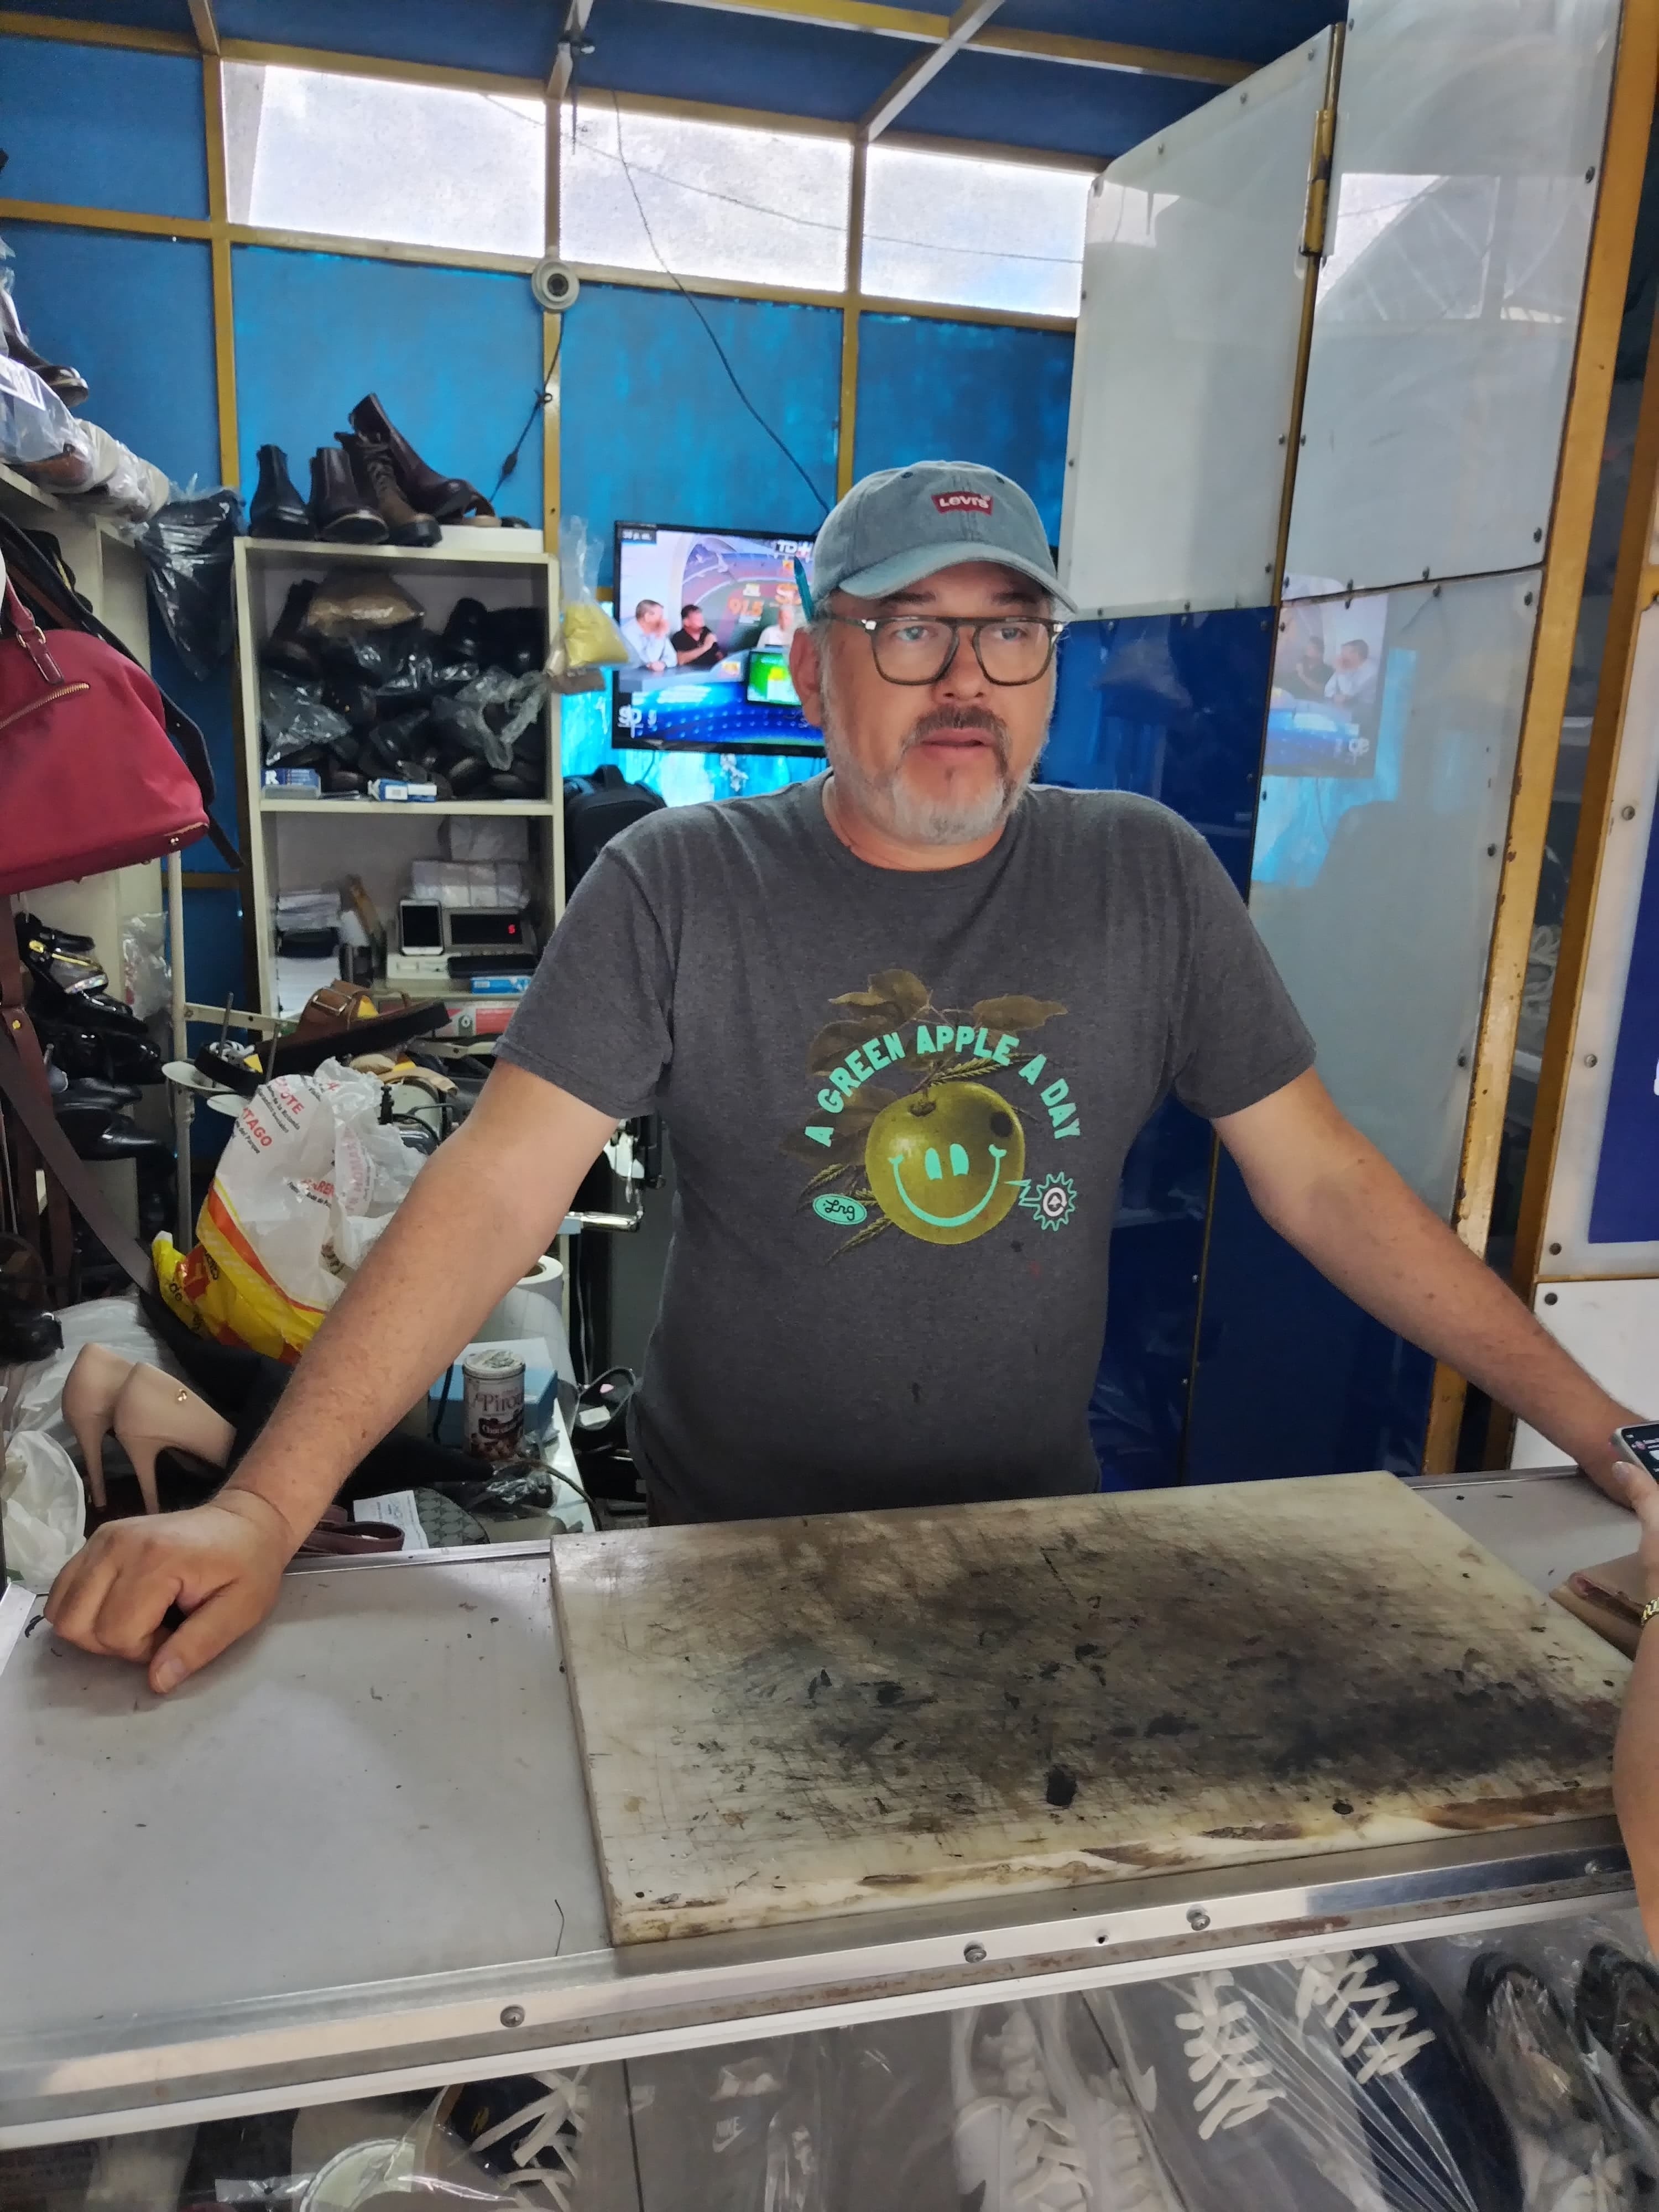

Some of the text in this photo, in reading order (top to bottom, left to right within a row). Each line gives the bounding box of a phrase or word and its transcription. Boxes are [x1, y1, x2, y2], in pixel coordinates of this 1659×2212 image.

[805, 1025, 1081, 1147] A GREEN APPLE A DAY
[243, 1108, 273, 1147] TAGO
